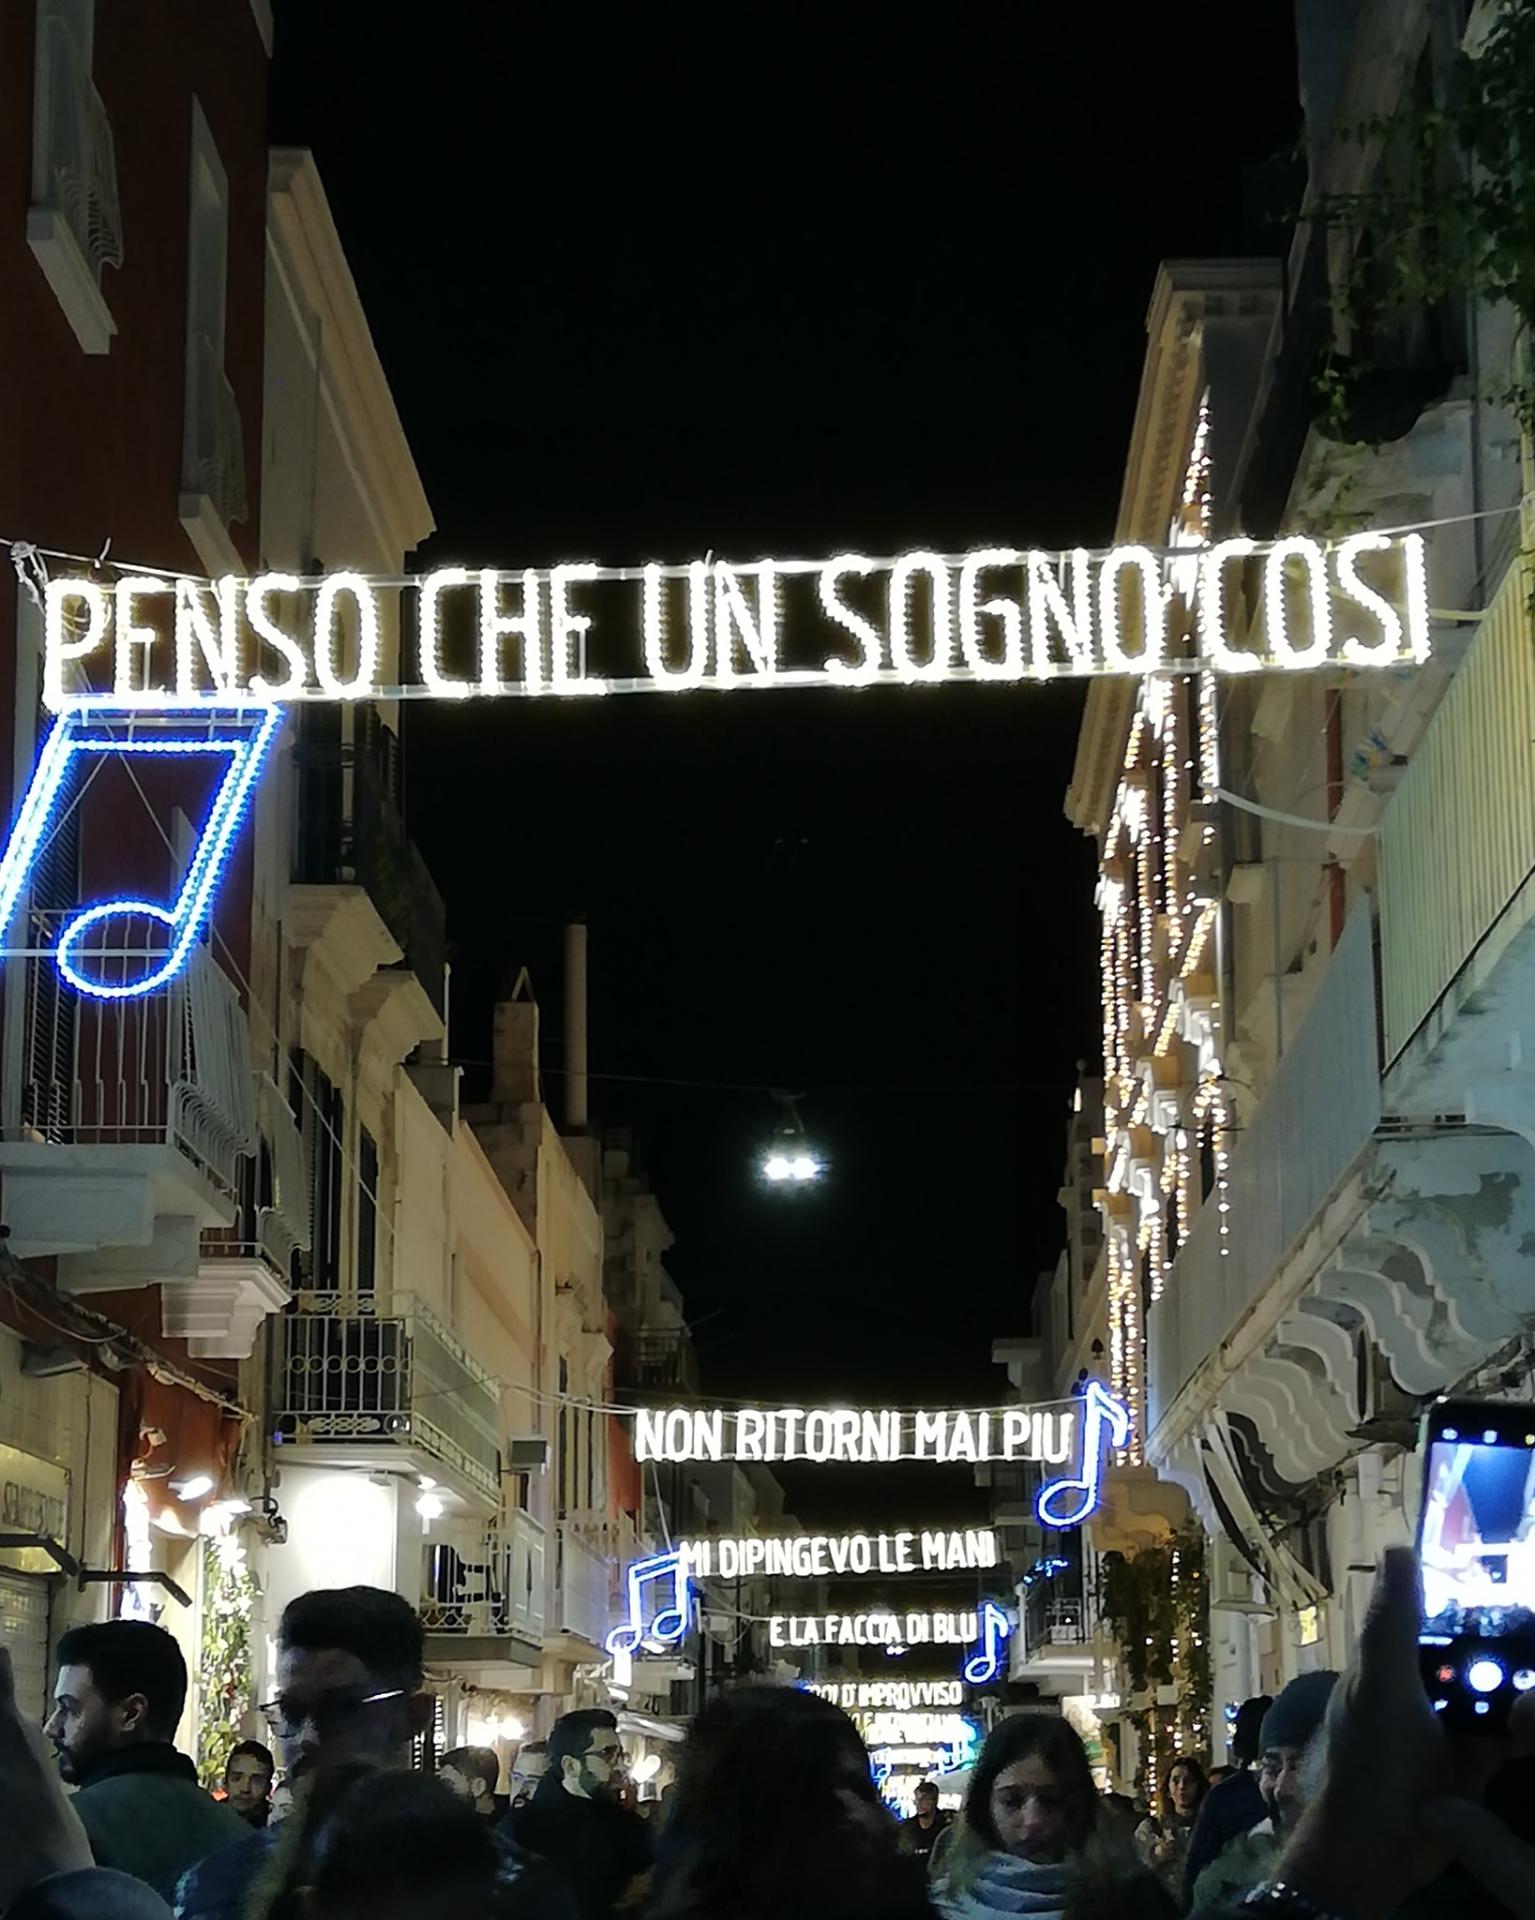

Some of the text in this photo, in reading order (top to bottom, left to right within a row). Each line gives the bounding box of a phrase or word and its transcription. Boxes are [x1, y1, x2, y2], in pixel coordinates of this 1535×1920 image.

[44, 572, 379, 709] PENSO
[418, 568, 606, 699] CHE
[642, 560, 783, 692] UN
[818, 545, 1167, 685] SOGNO
[635, 1409, 722, 1462] NON
[736, 1409, 901, 1462] RITORNI
[915, 1410, 990, 1462] MAI
[679, 1530, 996, 1579] MI DIPINGEVO LE MANI
[770, 1612, 977, 1647] E LA FACCIA DI BLU
